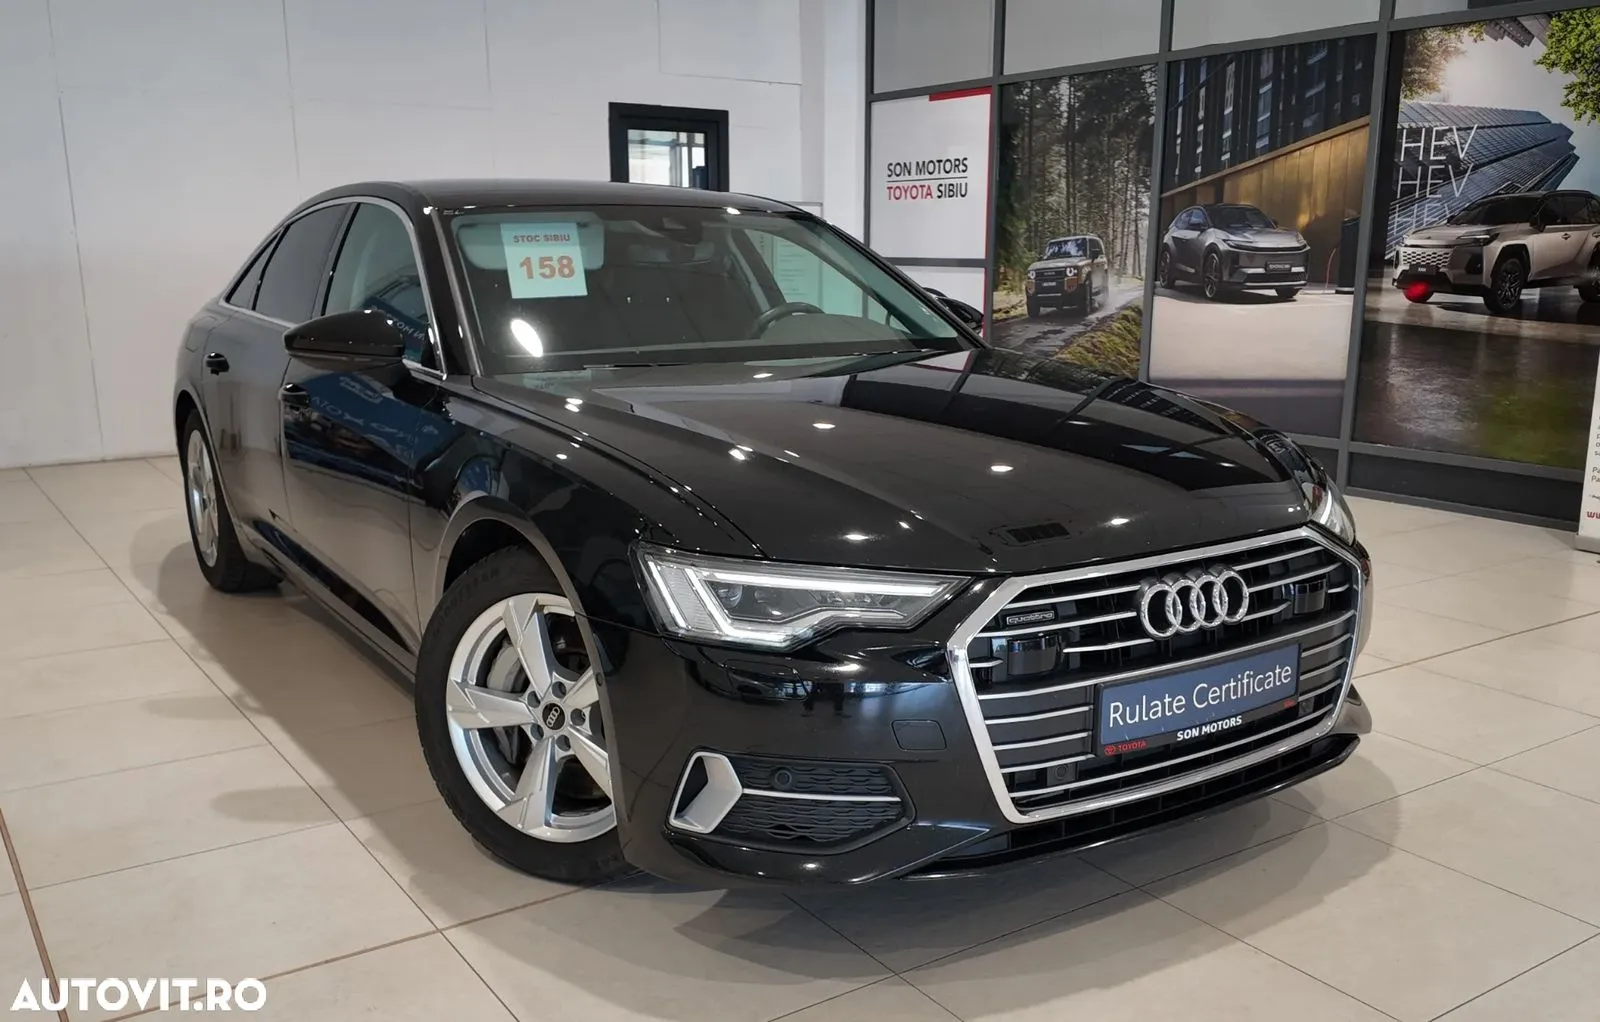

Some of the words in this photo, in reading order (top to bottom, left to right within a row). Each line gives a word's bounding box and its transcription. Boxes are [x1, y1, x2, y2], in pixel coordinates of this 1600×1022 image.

[1400, 124, 1478, 162] HEV
[887, 161, 912, 178] SON
[915, 157, 968, 176] MOTORS
[887, 184, 933, 200] TOYOTA
[936, 182, 968, 199] SIBIU
[1396, 162, 1474, 199] HEV
[513, 234, 540, 243] STOC
[543, 233, 571, 242] SIBIU
[519, 255, 575, 280] 158
[1109, 694, 1186, 728] Rulate
[1192, 664, 1292, 709] Certificate
[1176, 726, 1200, 741] SON
[1201, 715, 1243, 736] MOTORS
[1117, 740, 1147, 752] TOYOTA
